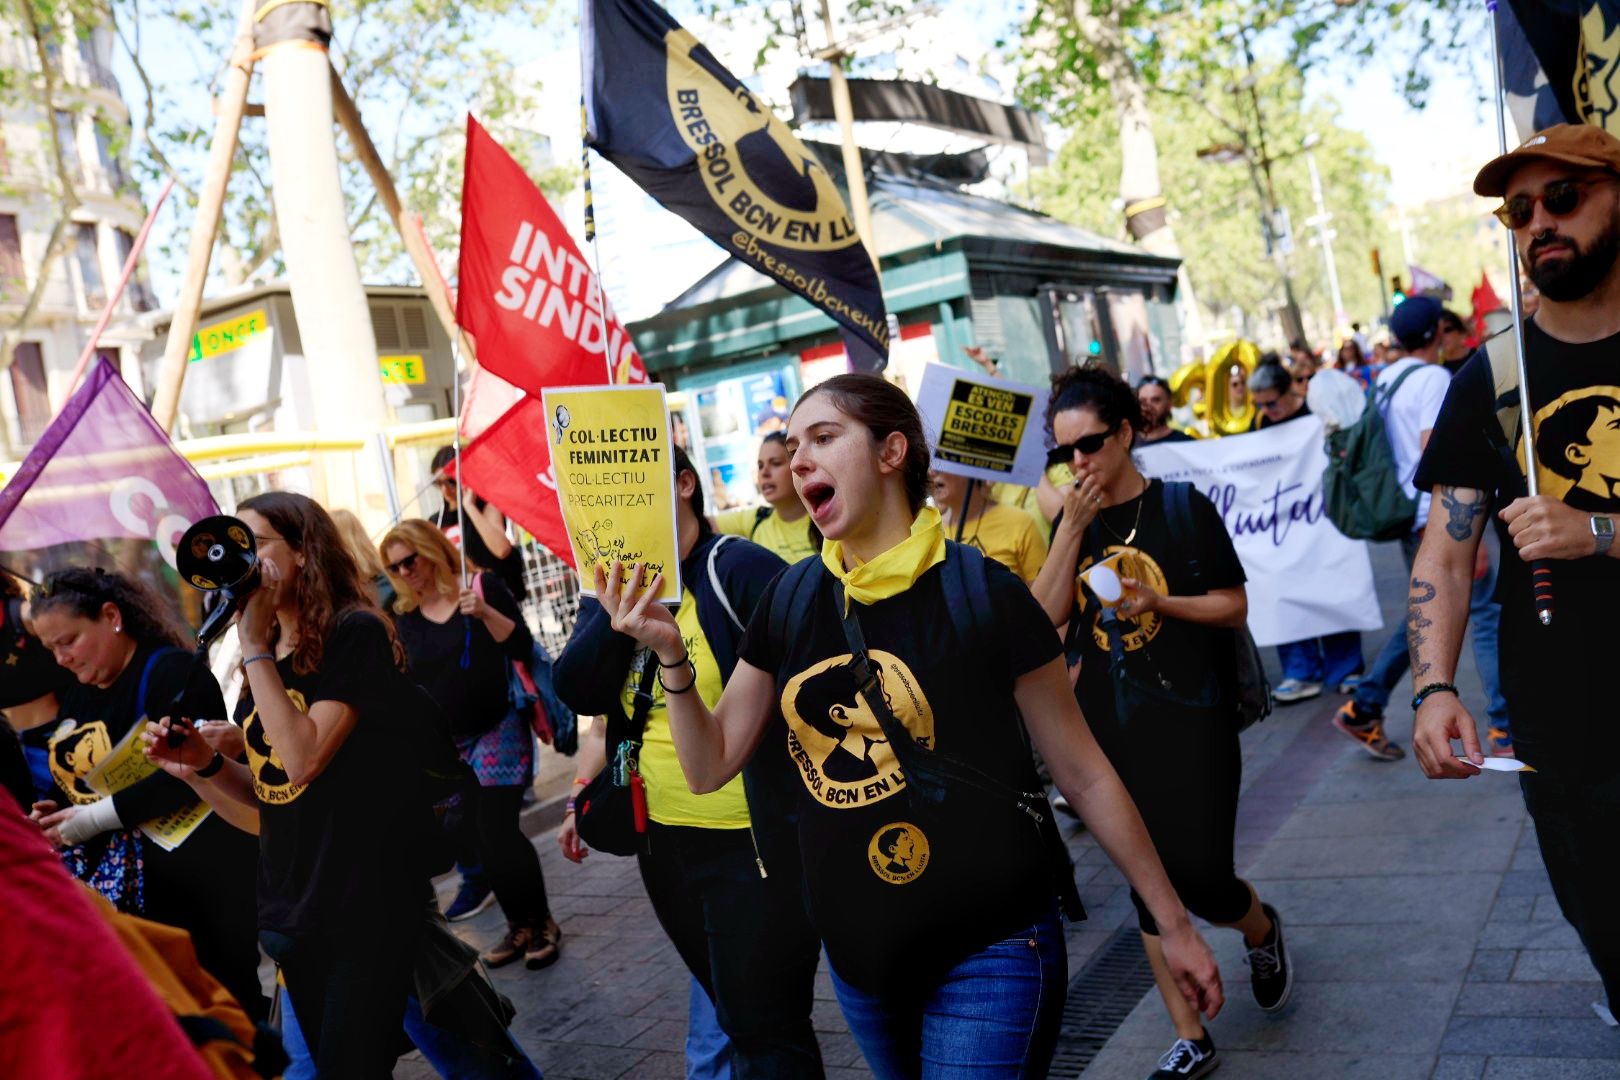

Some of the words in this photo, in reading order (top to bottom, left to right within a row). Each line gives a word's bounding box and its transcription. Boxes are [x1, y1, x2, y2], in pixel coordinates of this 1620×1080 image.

[677, 89, 737, 195] BRESSOL
[729, 190, 782, 235] BCN
[783, 219, 821, 243] EN
[955, 405, 1018, 429] ESCOLES
[569, 427, 657, 444] COL·LECTIU
[950, 418, 1016, 442] BRESSOL
[569, 448, 660, 464] FEMINITZAT
[568, 493, 655, 507] PRECARITZAT
[826, 787, 859, 804] BCN
[864, 778, 890, 800] EN
